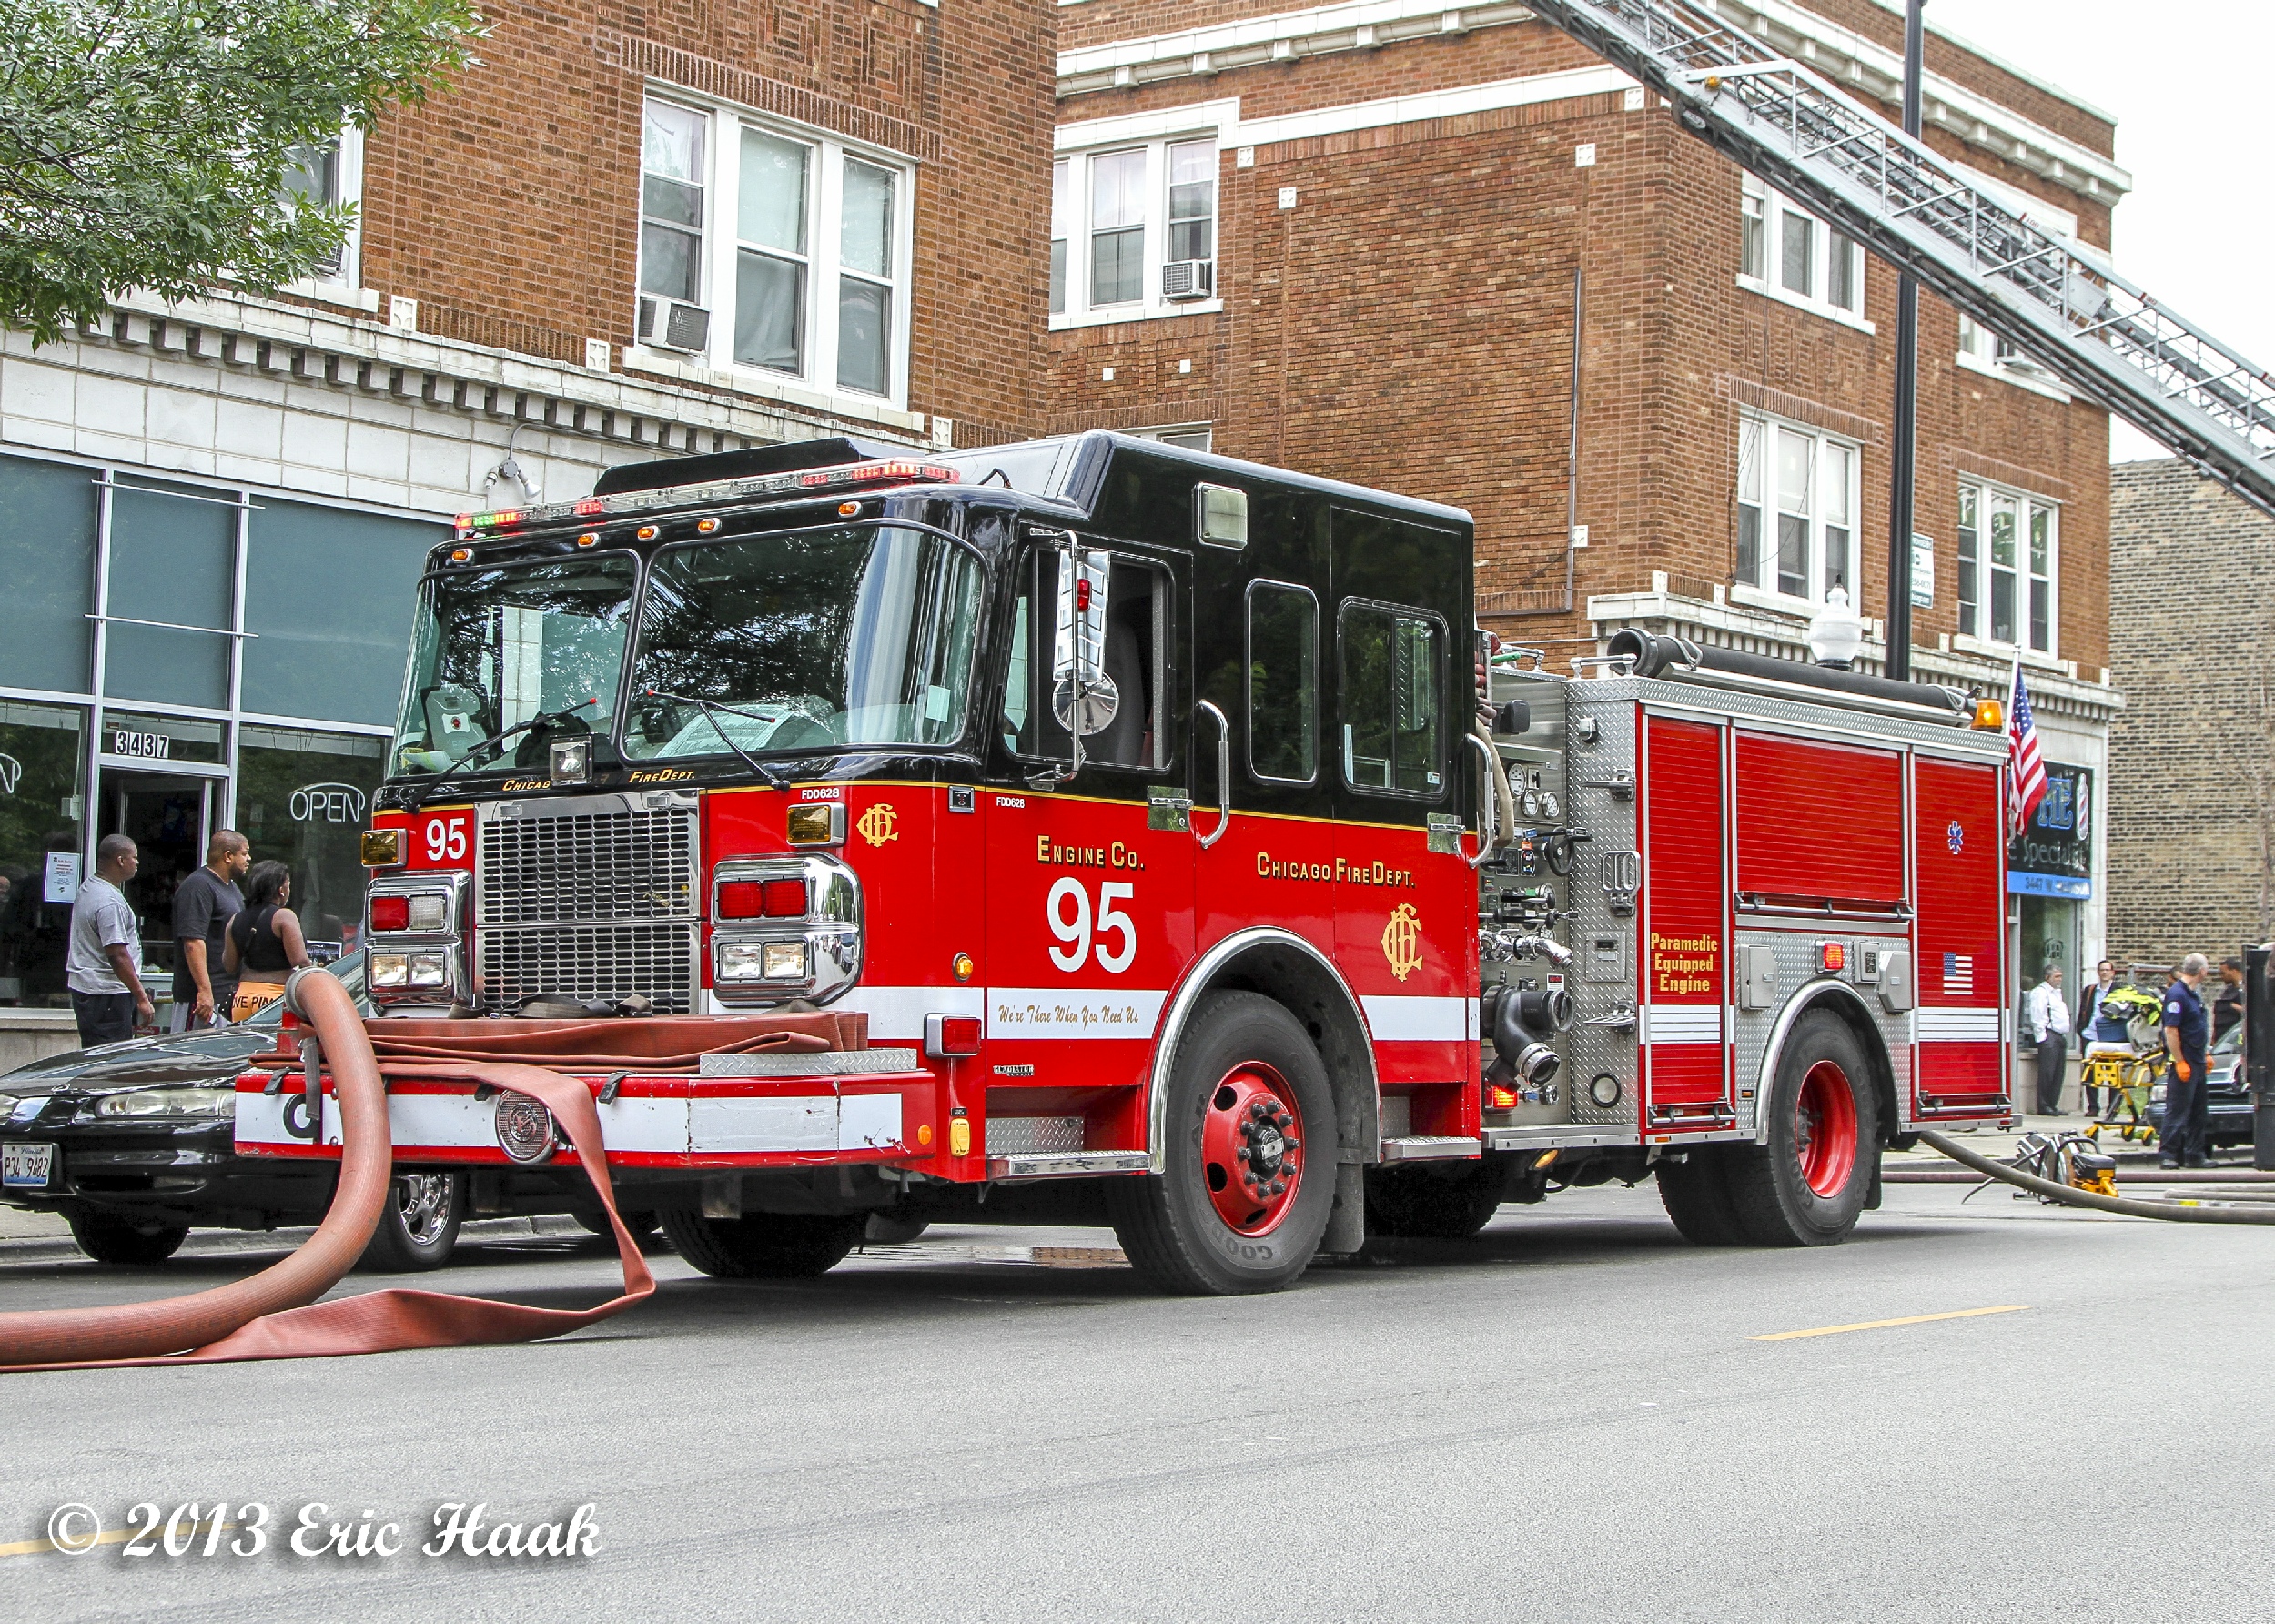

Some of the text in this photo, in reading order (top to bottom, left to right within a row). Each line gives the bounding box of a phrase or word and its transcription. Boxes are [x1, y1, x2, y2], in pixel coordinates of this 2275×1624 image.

[117, 732, 167, 758] 3437
[290, 791, 360, 822] OPEN
[801, 787, 840, 800] FDD628
[996, 796, 1026, 809] FDD628
[426, 817, 467, 861] 95
[1037, 835, 1146, 870] ENGINE CO.
[1257, 852, 1418, 888] CHICAGO FIRE DEPT.
[1046, 876, 1137, 973] 95
[1650, 932, 1718, 952] Paramedic
[1654, 953, 1714, 974] Equipped
[1659, 973, 1710, 994] Engine
[998, 1004, 1139, 1031] We're There When You Need Us
[5, 1156, 49, 1178] P34 9482
